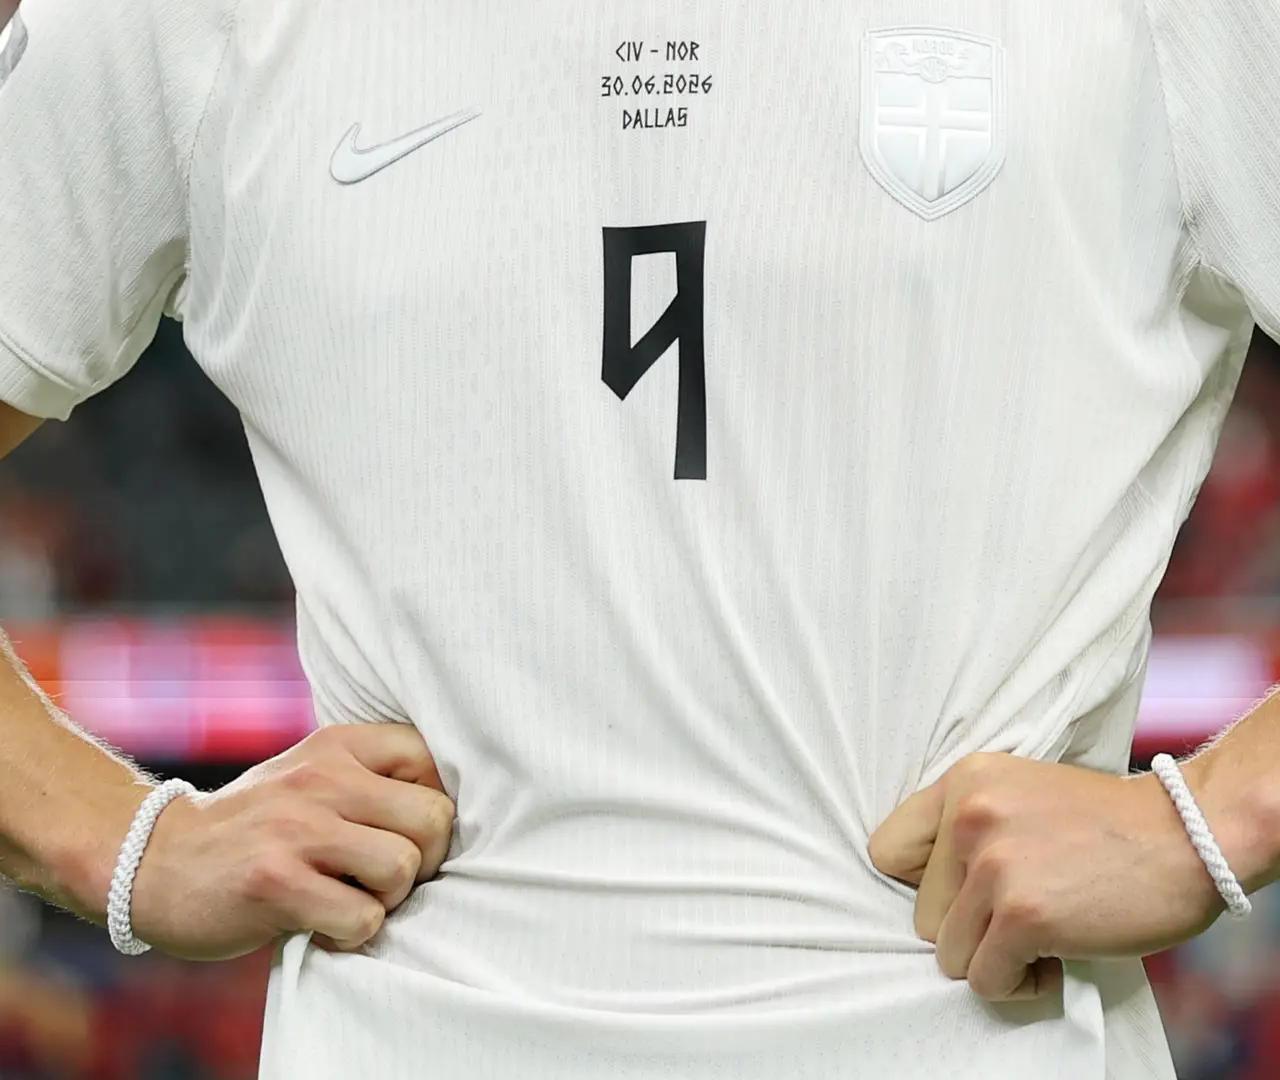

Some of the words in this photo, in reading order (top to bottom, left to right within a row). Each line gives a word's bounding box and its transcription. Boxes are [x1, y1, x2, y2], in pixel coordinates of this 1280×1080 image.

[615, 41, 643, 62] CIV
[666, 41, 700, 61] NOR
[601, 74, 713, 97] 30.06.2026
[622, 107, 688, 130] DALLAS
[601, 220, 707, 480] 9
